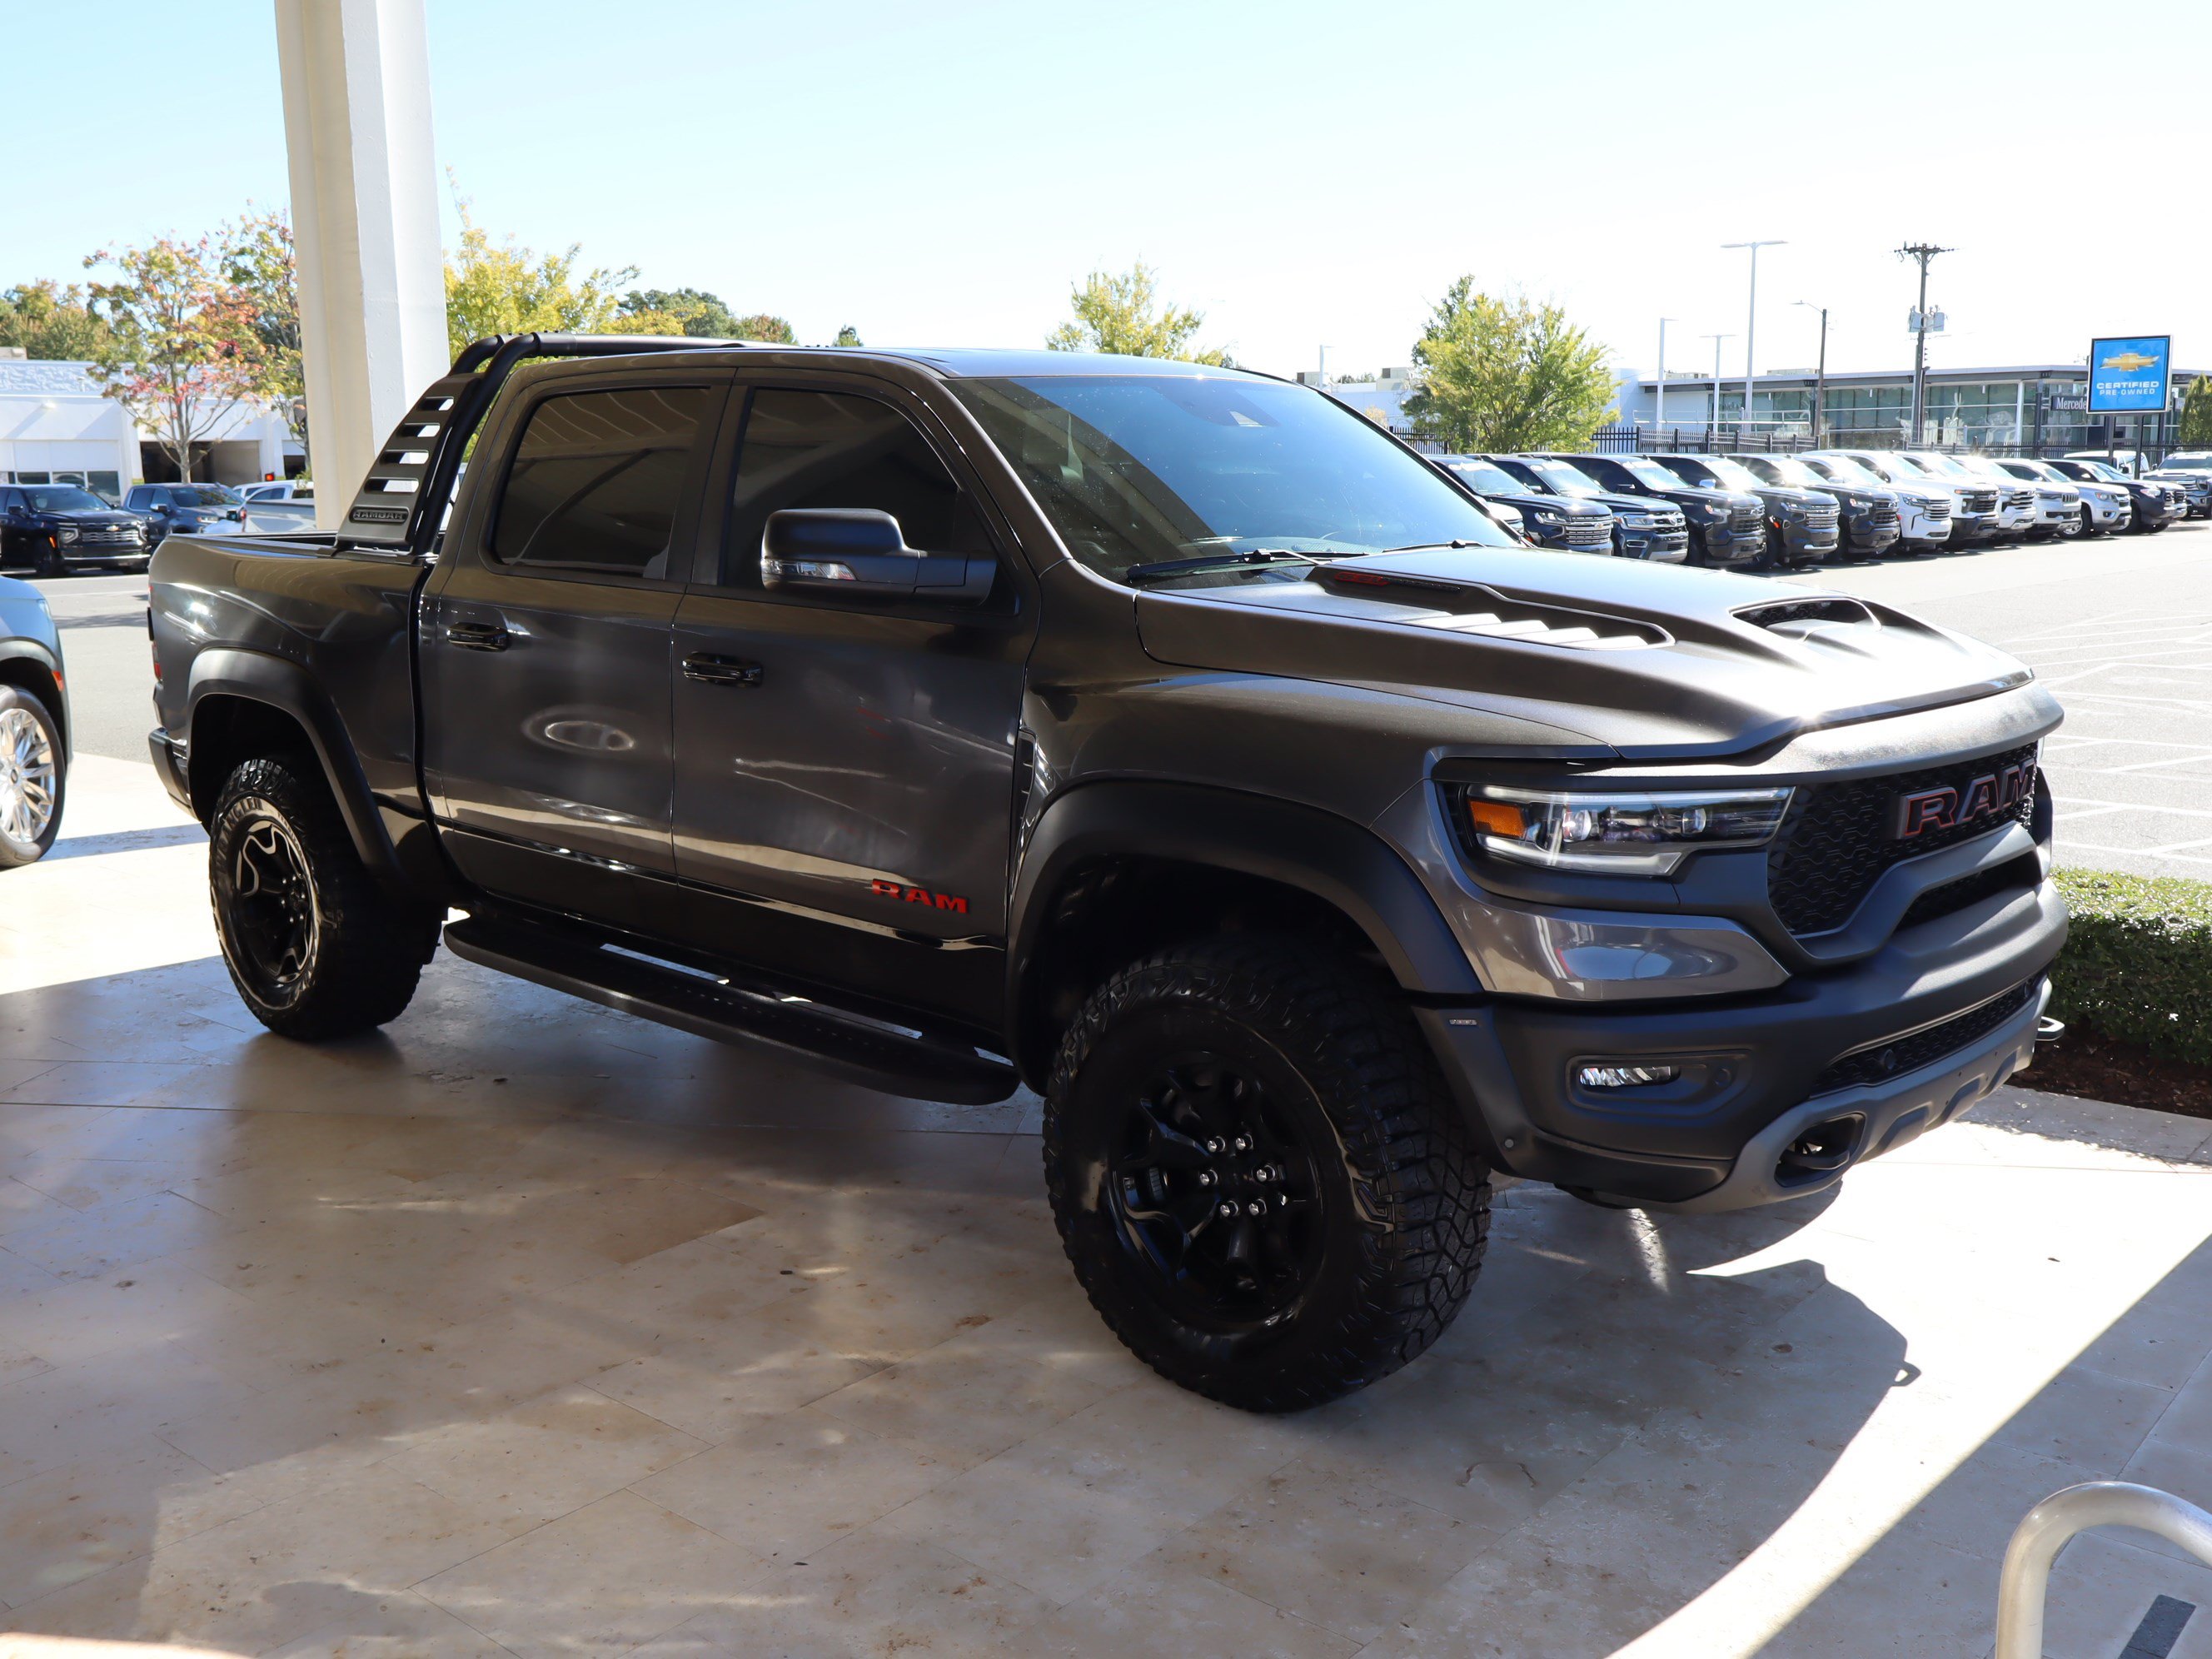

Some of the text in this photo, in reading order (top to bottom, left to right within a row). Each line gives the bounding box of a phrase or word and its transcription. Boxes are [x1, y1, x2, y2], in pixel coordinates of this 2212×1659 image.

[2096, 381, 2160, 389] CERTIFIED
[1898, 759, 2037, 838] RAM
[871, 879, 968, 914] RAM
